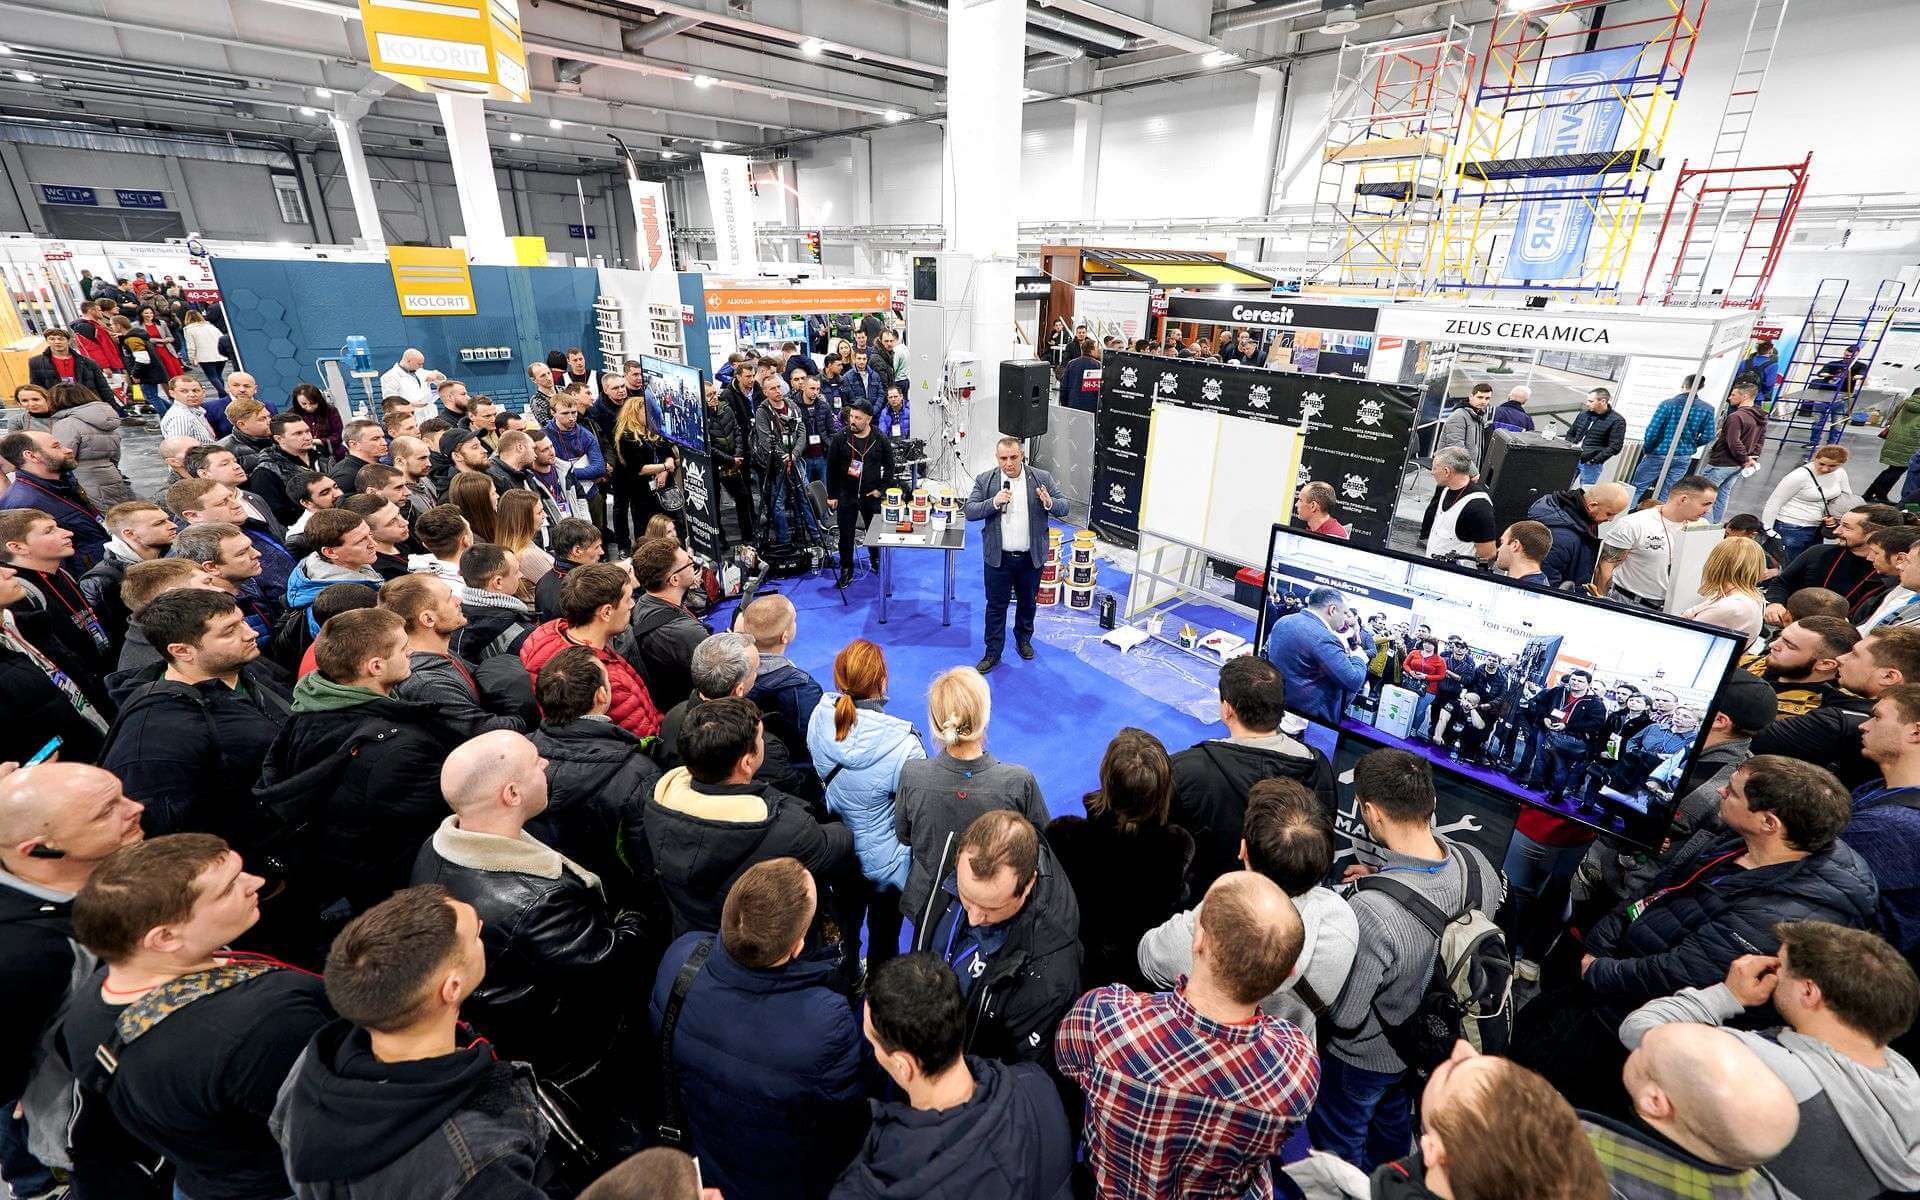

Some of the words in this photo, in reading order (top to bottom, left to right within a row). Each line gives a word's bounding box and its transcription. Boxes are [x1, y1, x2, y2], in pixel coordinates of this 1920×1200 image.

[386, 41, 480, 67] KOLORIT
[46, 188, 64, 196] WC
[118, 192, 136, 200] WC
[408, 297, 465, 307] KOLORIT
[1868, 304, 1915, 313] Chinese
[1232, 305, 1295, 324] Ceresit
[1445, 319, 1492, 335] ZEUS
[1497, 322, 1610, 344] CERAMICA
